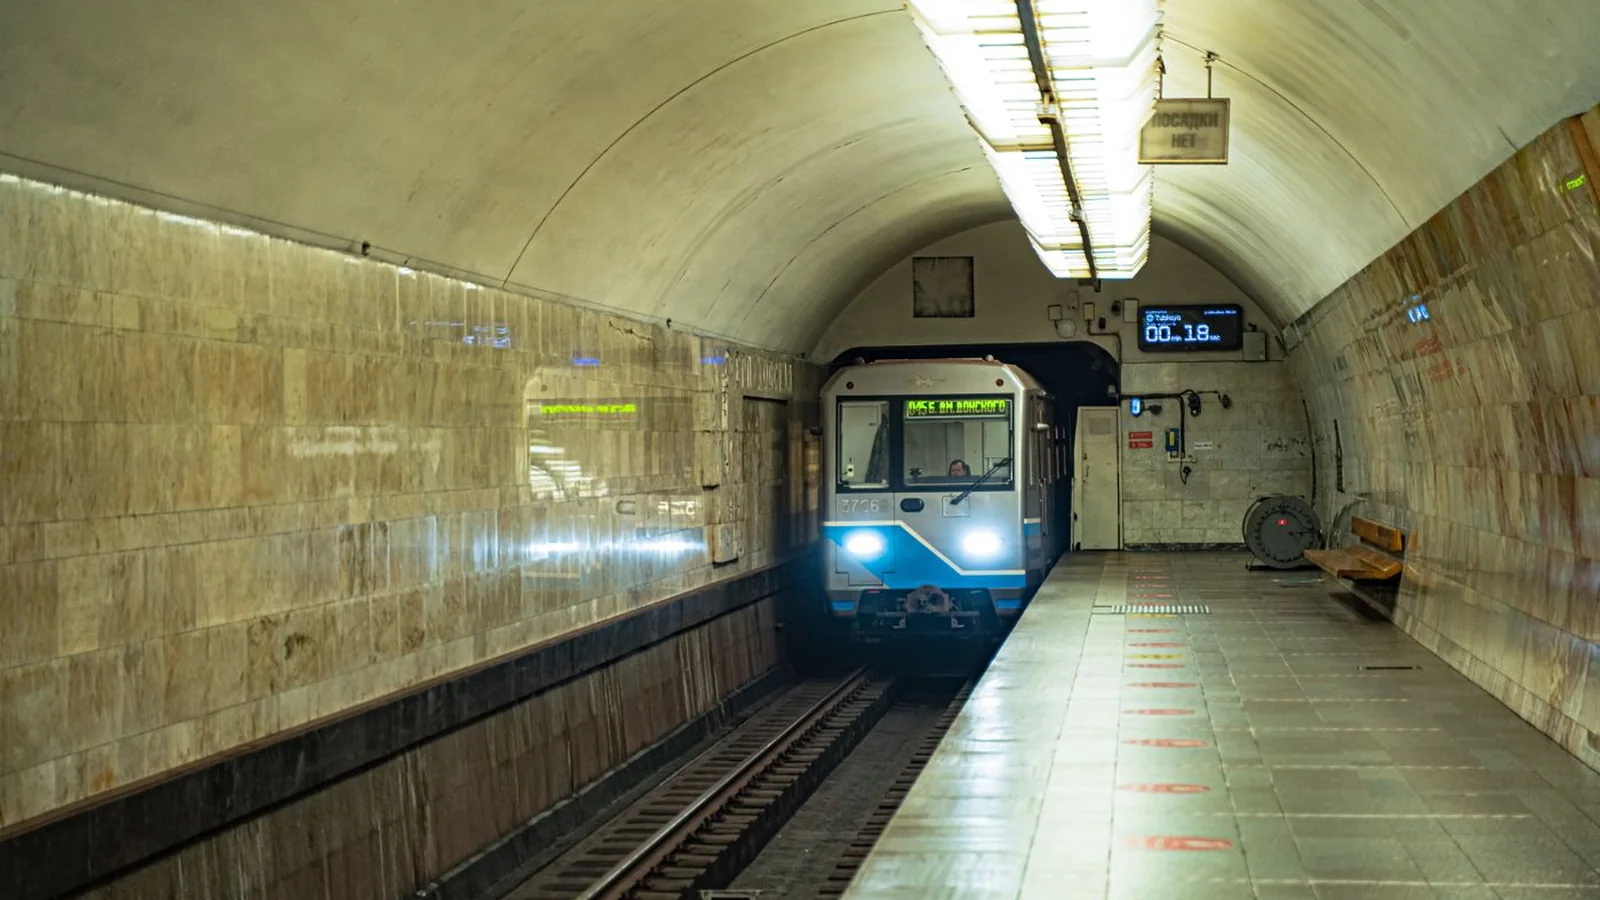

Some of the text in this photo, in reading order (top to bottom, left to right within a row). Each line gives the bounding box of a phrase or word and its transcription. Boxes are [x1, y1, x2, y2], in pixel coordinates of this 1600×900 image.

[1171, 134, 1197, 148] НЕТ
[1146, 326, 1171, 342] 00
[1184, 324, 1209, 341] 18
